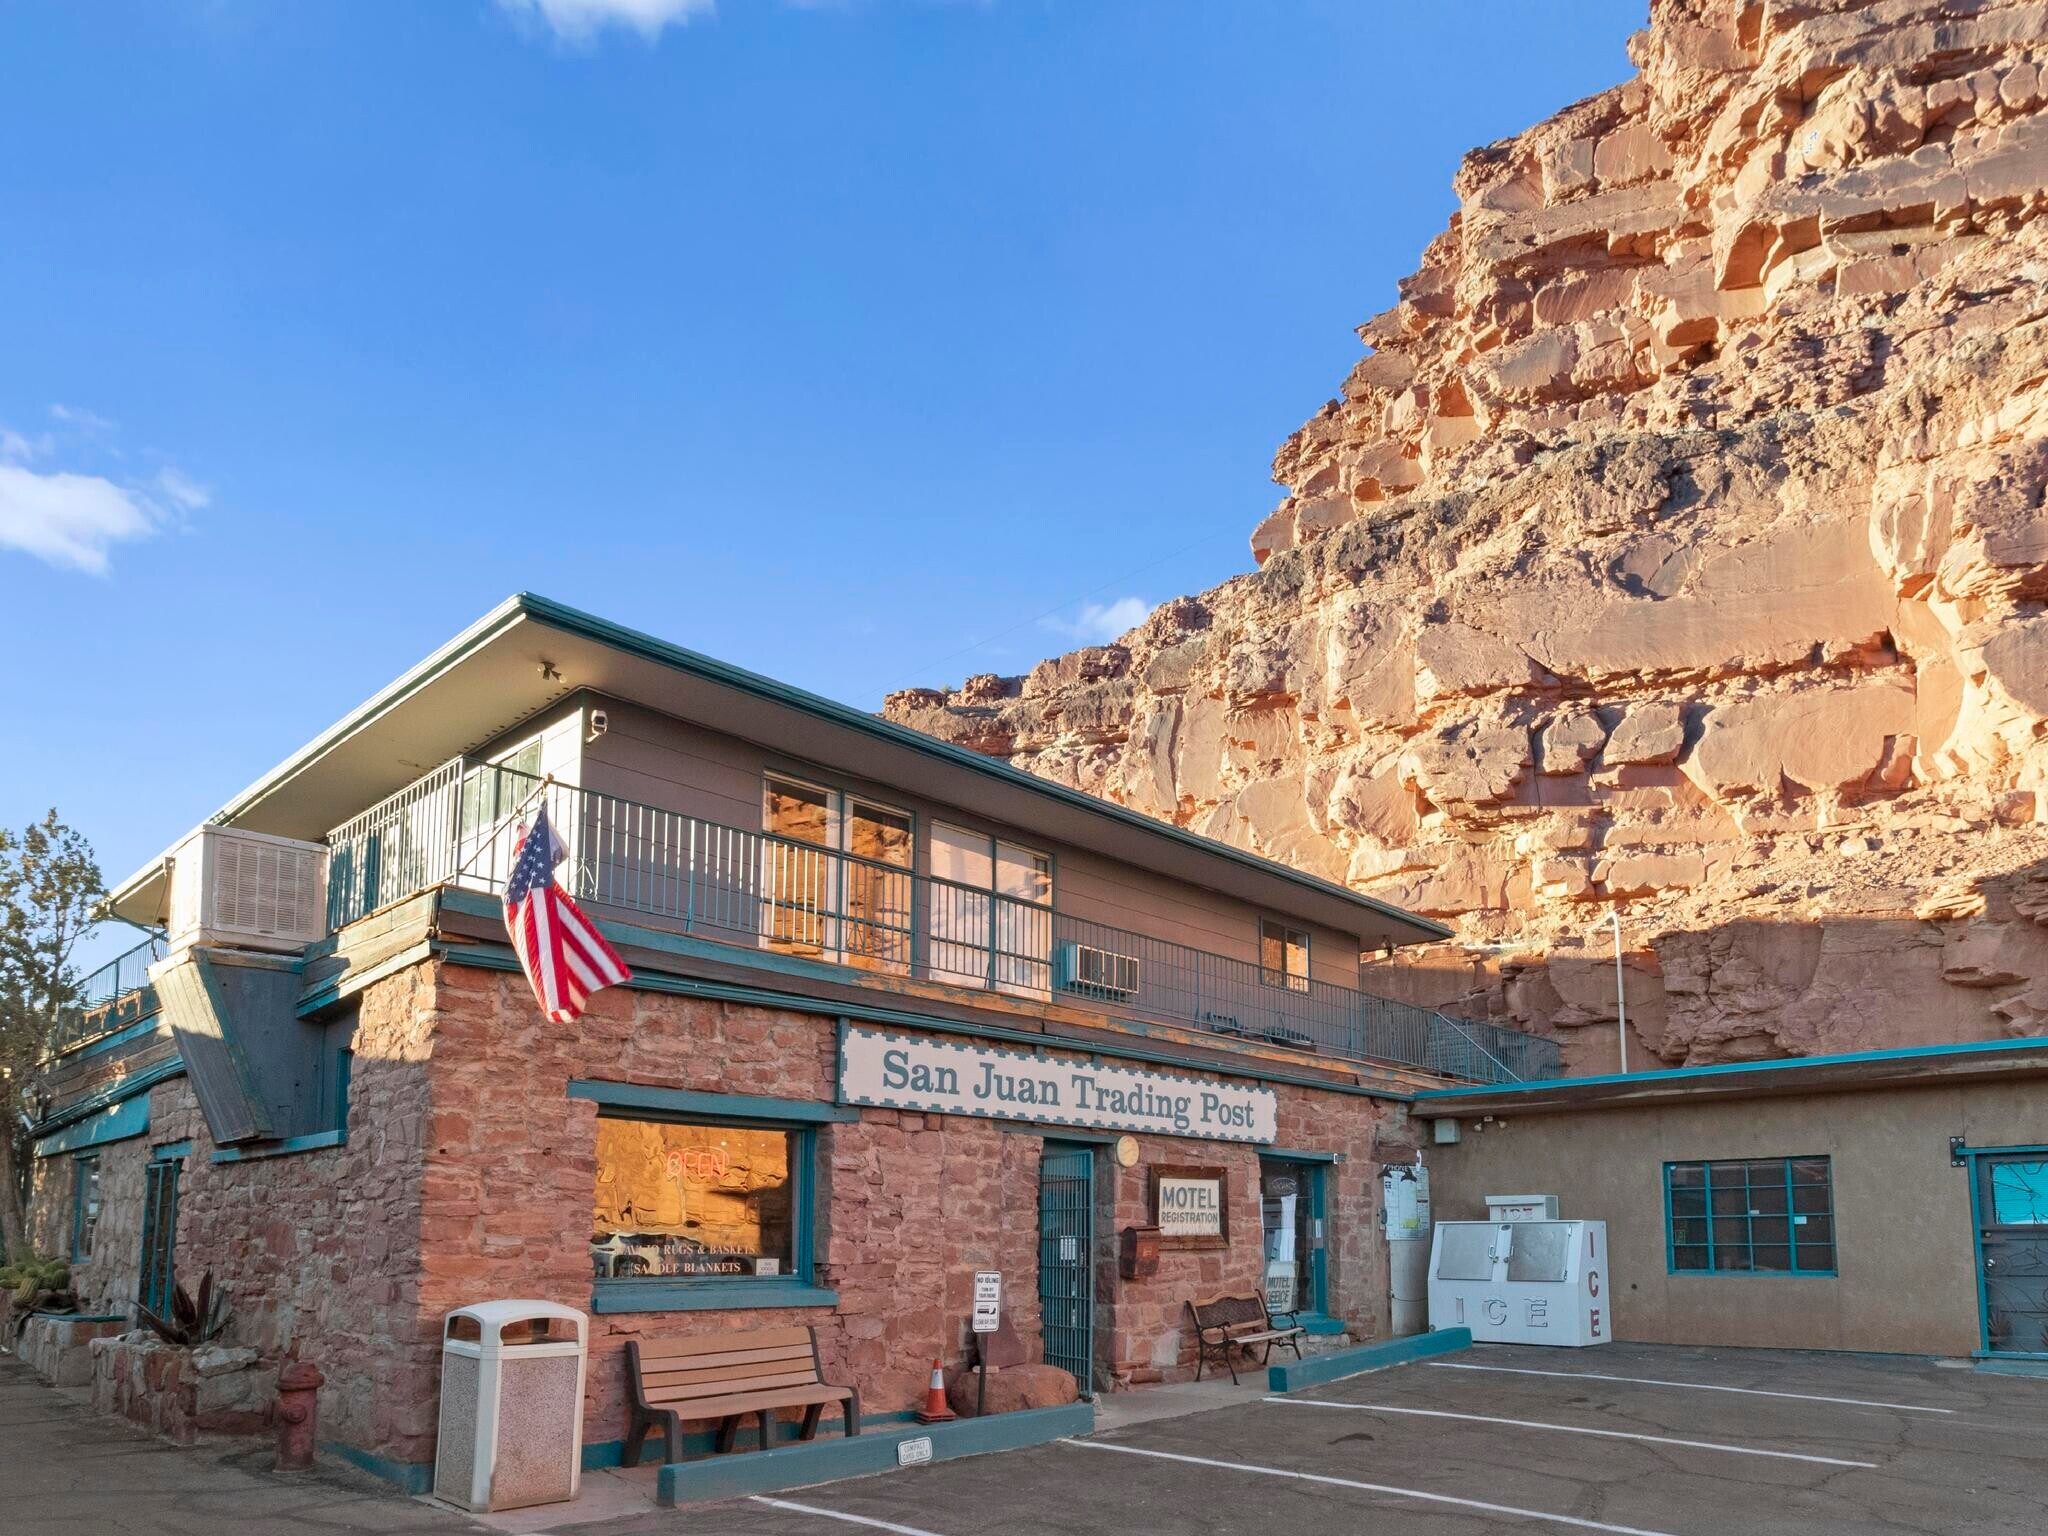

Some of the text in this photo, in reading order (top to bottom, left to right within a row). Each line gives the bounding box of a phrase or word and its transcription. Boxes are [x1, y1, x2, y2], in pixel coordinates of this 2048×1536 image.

[882, 1049, 1255, 1131] San Juan Trading Post
[667, 1151, 727, 1178] OPEN
[1162, 1185, 1217, 1209] MOTEL
[1161, 1211, 1218, 1224] REGISTRATION
[663, 1245, 694, 1255] RUGS
[697, 1245, 705, 1255] &
[709, 1245, 755, 1255] BASKETS
[684, 1262, 741, 1273] BLANKETS
[1267, 1277, 1290, 1289] MOTEL
[1266, 1290, 1290, 1304] OFFICE
[1455, 1297, 1548, 1328] ICE
